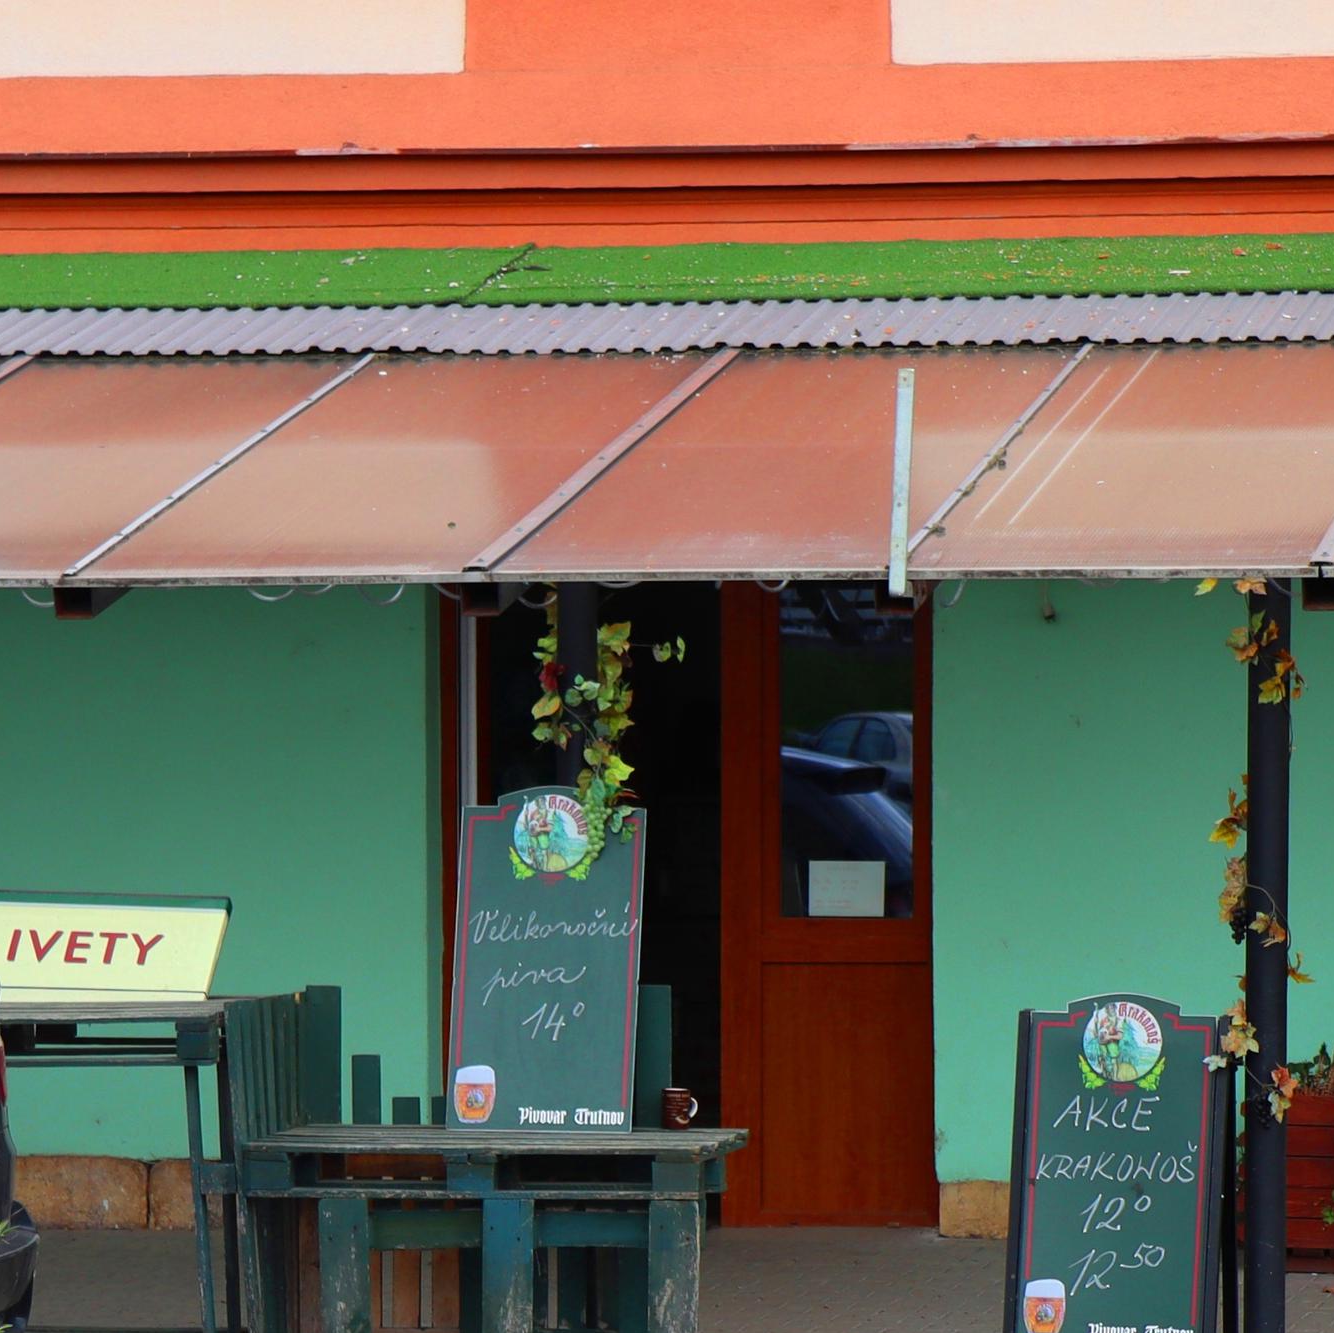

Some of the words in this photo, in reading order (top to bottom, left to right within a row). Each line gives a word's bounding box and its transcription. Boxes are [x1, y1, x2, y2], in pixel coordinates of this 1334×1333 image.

[469, 901, 638, 944] Velikonoční
[6, 928, 165, 966] IVETY
[482, 962, 587, 1006] piva
[518, 1106, 567, 1125] Pivovar
[574, 1107, 625, 1126] Trutnov
[1053, 1095, 1161, 1132] AKCE
[1035, 1140, 1198, 1183] KRAKONOŠ
